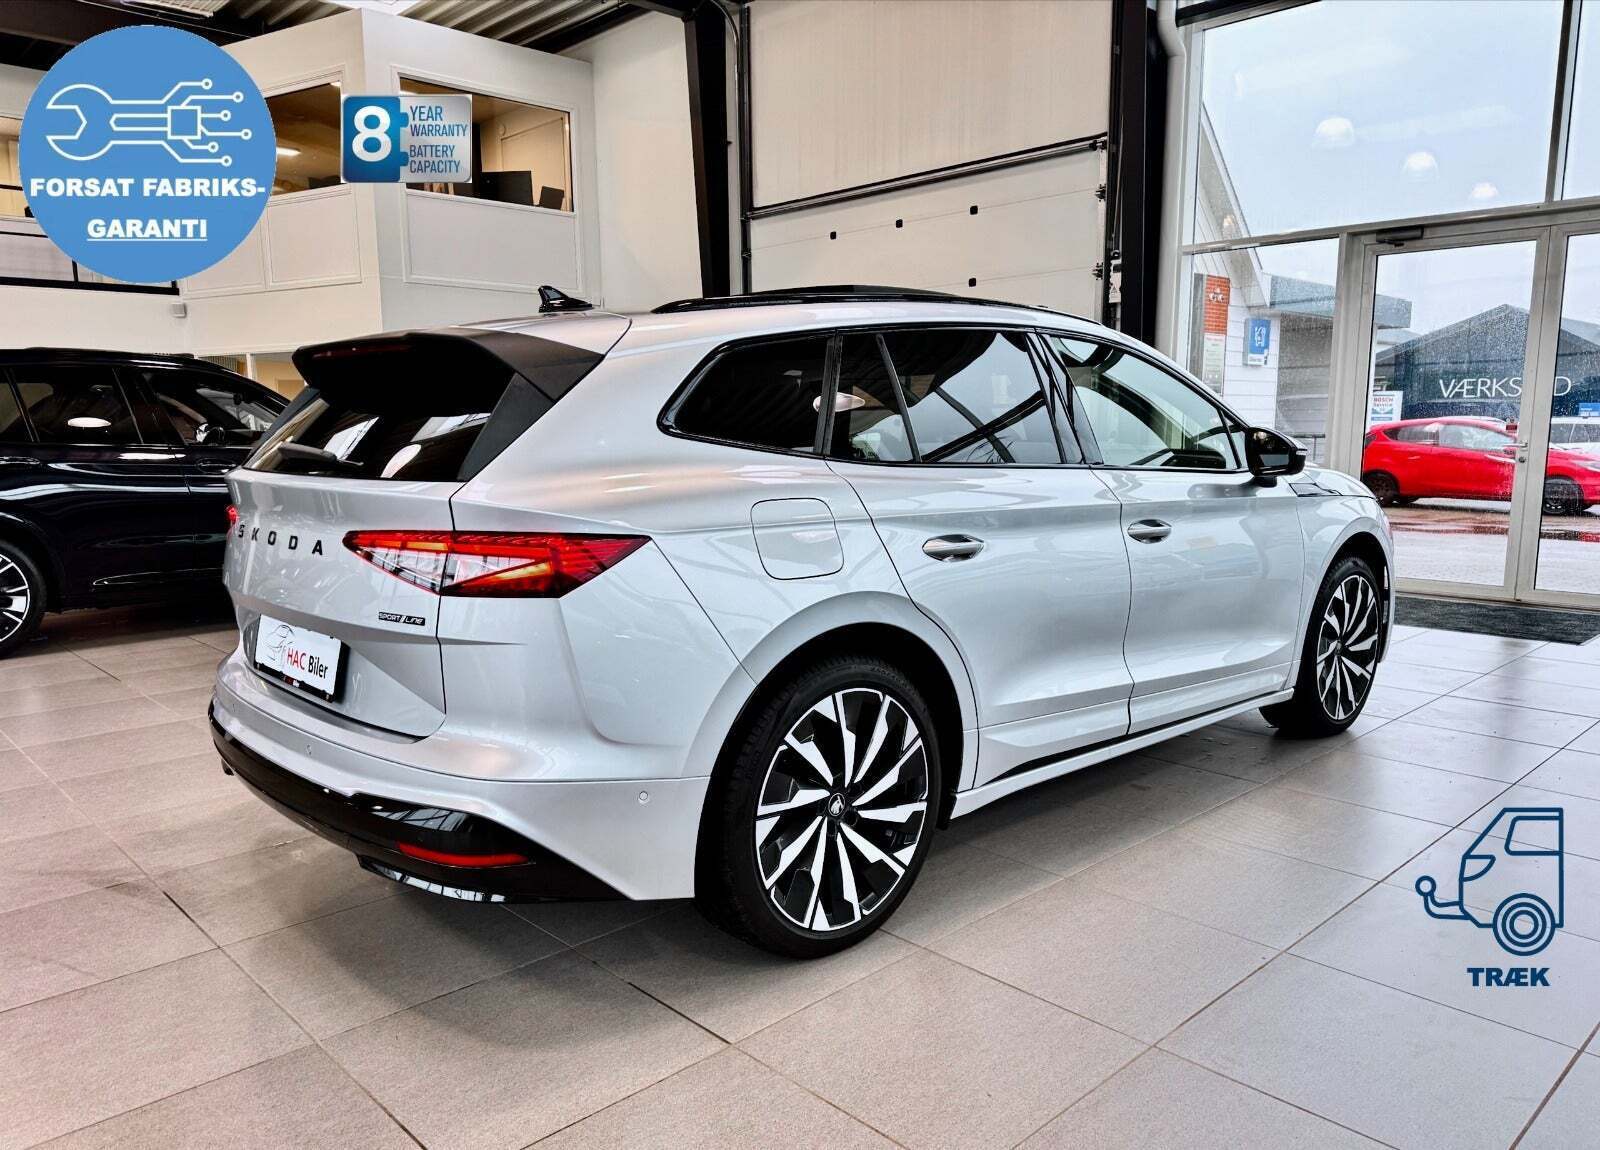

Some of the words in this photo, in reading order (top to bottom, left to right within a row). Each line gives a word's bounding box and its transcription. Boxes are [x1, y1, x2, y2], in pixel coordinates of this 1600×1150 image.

[1439, 376, 1572, 398] VÆRKSD
[286, 647, 307, 670] HAC
[307, 655, 328, 679] Biler
